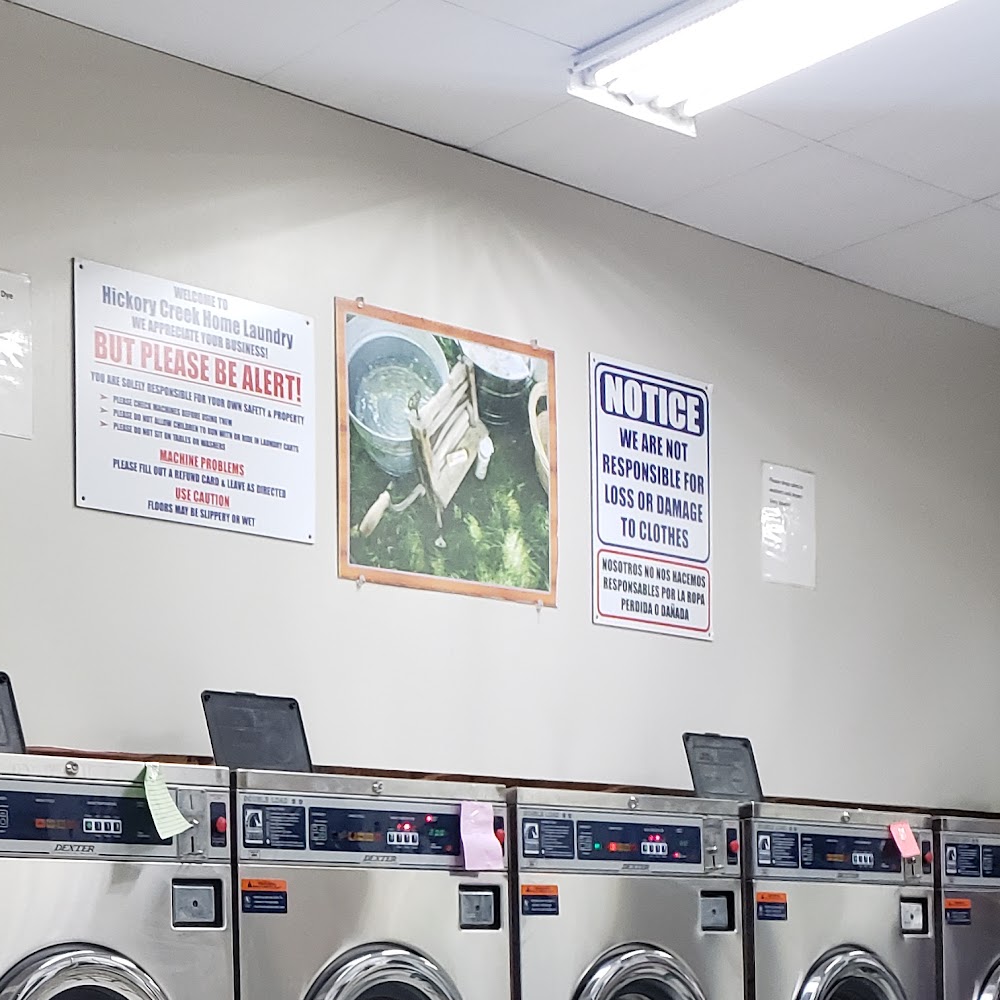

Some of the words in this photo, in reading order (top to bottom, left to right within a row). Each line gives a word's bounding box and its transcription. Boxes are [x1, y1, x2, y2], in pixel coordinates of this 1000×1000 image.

[1, 290, 13, 299] Dye
[173, 285, 215, 308] WELCOME
[217, 297, 228, 310] TO
[102, 285, 156, 317] Hickory
[160, 299, 200, 326] Creek
[203, 309, 240, 335] Home
[243, 319, 293, 350] Laundry
[132, 316, 146, 330] WE
[148, 320, 199, 342] APPRECIATE
[201, 331, 224, 348] YOUR
[225, 338, 268, 359] BUSINESS!
[94, 330, 135, 366] BUT
[140, 340, 209, 382] PLEASE
[215, 357, 237, 388] BE
[242, 364, 301, 402] ALERT!
[91, 371, 105, 383] YOU
[107, 374, 120, 386] ARE
[122, 378, 145, 391] SOLELY
[147, 383, 192, 401] RESPONSIBLE
[194, 392, 206, 404] FOR
[208, 395, 225, 408] YOUR
[227, 400, 242, 412] OWN
[244, 403, 266, 417] SAFETY
[268, 410, 271, 418] &
[274, 410, 304, 425] PROPERTY
[113, 395, 132, 406] PLEASE
[604, 373, 700, 434] NOTICE
[113, 408, 132, 420] PLEASE
[134, 413, 141, 421] DO
[143, 414, 153, 423] NOT
[174, 420, 198, 432] CHILDREN
[200, 426, 206, 434] TO
[113, 422, 132, 433] PLEASE
[134, 426, 141, 434] DO
[143, 428, 153, 437] NOT
[154, 430, 163, 439] SIT
[164, 432, 171, 440] ON
[173, 433, 191, 444] TABLES
[193, 438, 199, 446] OR
[201, 439, 225, 451] WASHERS
[620, 427, 638, 450] WE
[642, 433, 663, 456] ARE
[666, 438, 688, 462] NOT
[160, 449, 198, 467] MACHINE
[201, 457, 244, 476] PROBLEMS
[602, 454, 681, 489] RESPONSIBLE
[684, 472, 704, 495] FOR
[113, 458, 137, 472] PLEASE
[139, 463, 152, 474] FILL
[154, 466, 166, 477] OUT
[169, 469, 173, 478] A
[175, 470, 200, 482] REFUND
[202, 474, 219, 486] CARD
[221, 479, 225, 487] &
[227, 479, 245, 491] LEAVE
[247, 483, 255, 492] AS
[257, 485, 286, 498] DIRECTED
[175, 487, 191, 502] USE
[193, 490, 230, 507] CAUTION
[605, 484, 634, 509] LOSS
[638, 491, 653, 512] OR
[657, 494, 703, 523] DAMAGE
[148, 500, 173, 513] FLOORS
[175, 505, 188, 515] MAY
[190, 507, 198, 517] BE
[200, 509, 230, 522] SLIPPERY
[232, 514, 240, 524] OR
[242, 516, 255, 527] WET
[620, 517, 635, 538] TO
[640, 520, 688, 548] CLOTHES
[602, 558, 642, 576] NOSOTROS
[645, 566, 654, 579] NO
[656, 567, 670, 582] NOS
[672, 570, 706, 588] HACEMOS
[603, 577, 659, 598] RESPONSABLES
[662, 586, 675, 601] POR
[677, 590, 685, 602] LA
[687, 592, 705, 606] ROPA
[621, 598, 653, 614] PERDIDA
[654, 604, 659, 615] O
[661, 603, 689, 621] DAÑADA
[54, 844, 95, 853] DEXTER
